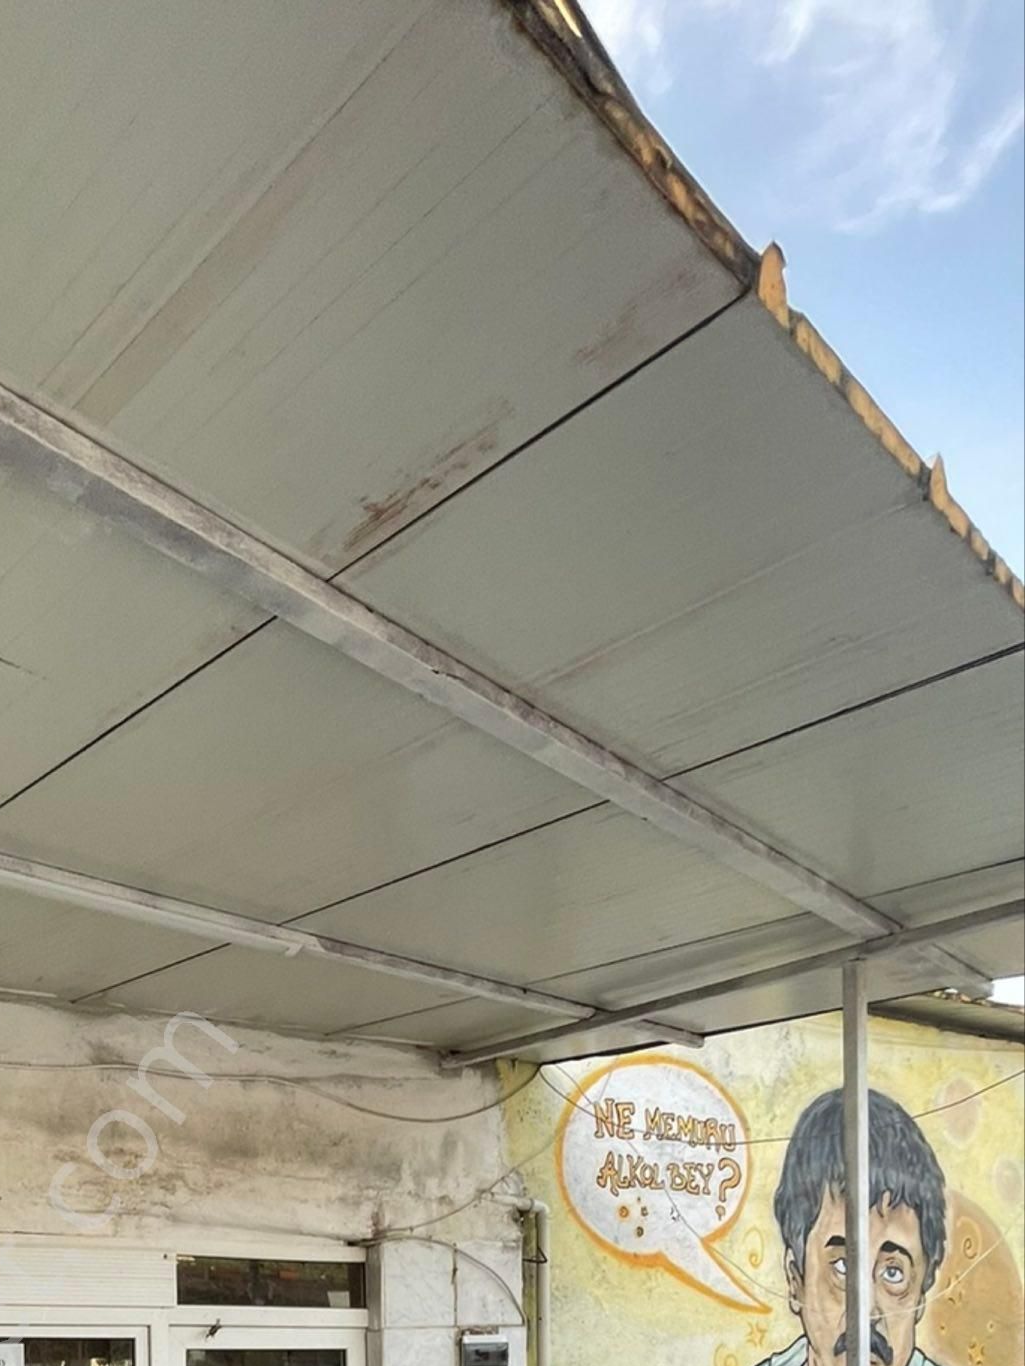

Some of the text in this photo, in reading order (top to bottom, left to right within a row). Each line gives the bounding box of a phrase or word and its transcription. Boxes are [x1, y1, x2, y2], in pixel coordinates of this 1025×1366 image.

[593, 1098, 736, 1153] NE MEMURU
[596, 1151, 666, 1197] ALKOL
